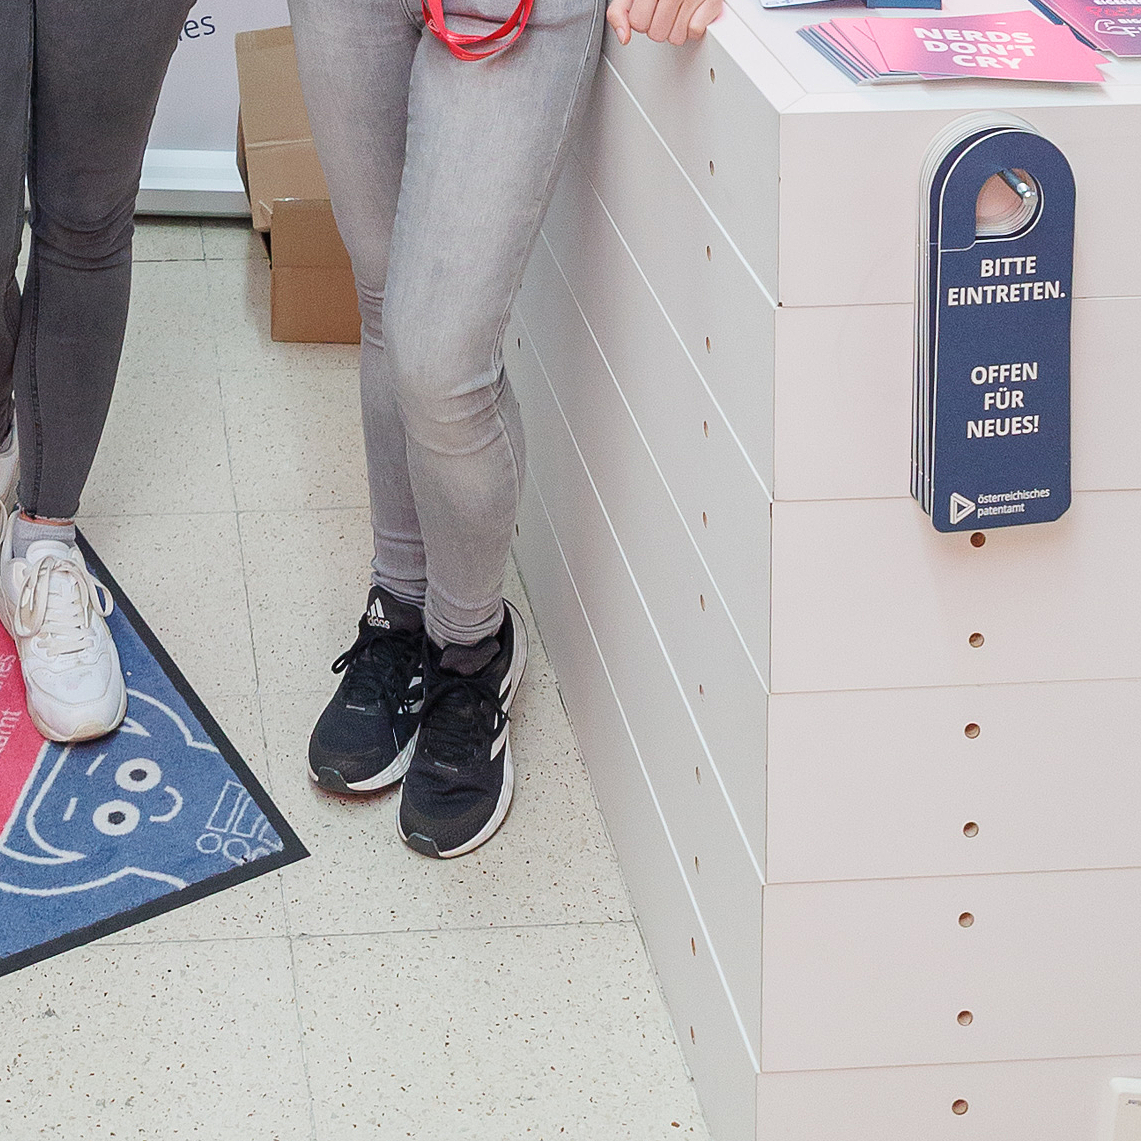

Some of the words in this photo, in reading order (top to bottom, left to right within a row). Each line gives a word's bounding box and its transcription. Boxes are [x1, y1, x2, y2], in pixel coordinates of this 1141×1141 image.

[913, 27, 1034, 44] NERDS
[922, 40, 1036, 57] DON'T
[952, 55, 1023, 70] CRY
[980, 255, 1037, 278] BITTE
[947, 280, 1066, 306] EINTRETEN.
[970, 361, 1038, 385] OFFEN
[984, 386, 1025, 411] FÜR
[966, 414, 1040, 439] NEUES!
[977, 488, 1051, 504] österreichisches
[977, 503, 1025, 519] patentamt
